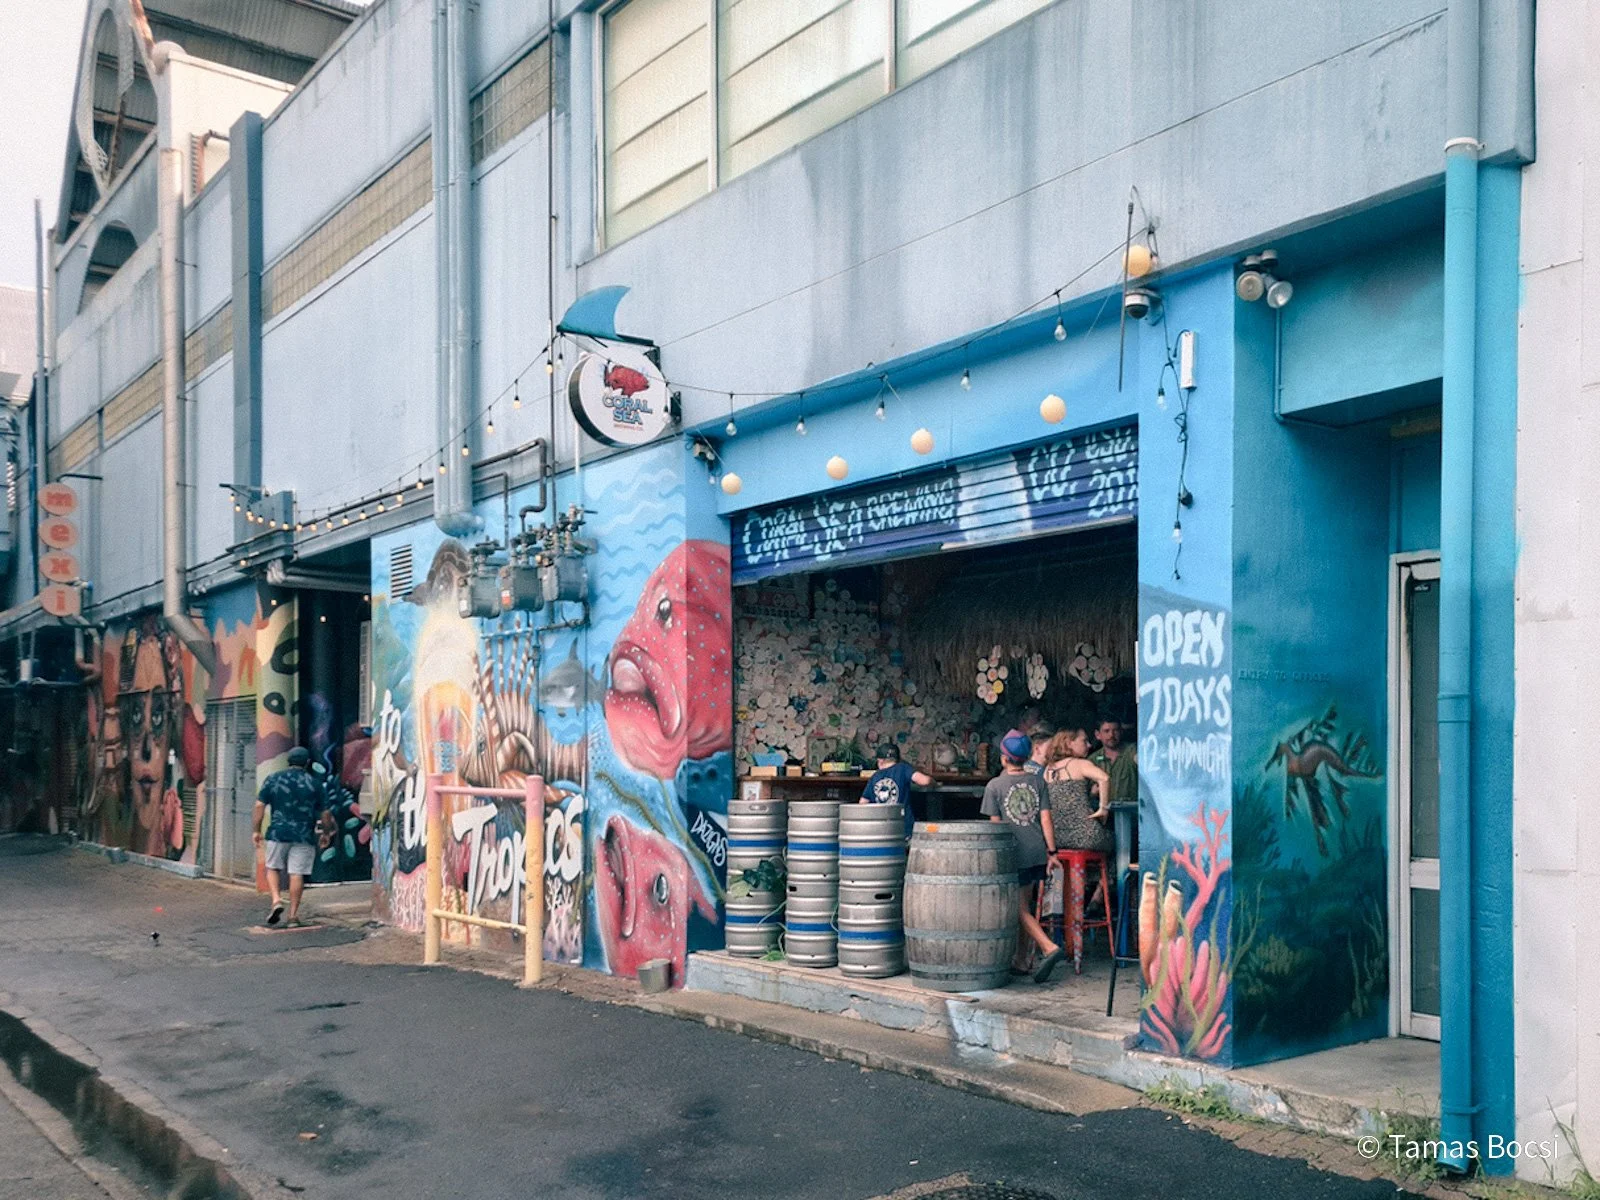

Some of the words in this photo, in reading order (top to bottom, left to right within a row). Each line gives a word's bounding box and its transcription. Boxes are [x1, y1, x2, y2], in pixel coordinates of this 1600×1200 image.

[602, 395, 653, 415] CORAL
[613, 409, 643, 426] SEA
[1143, 609, 1225, 668] OPEN
[399, 768, 429, 850] th
[452, 794, 584, 927] Tropcs
